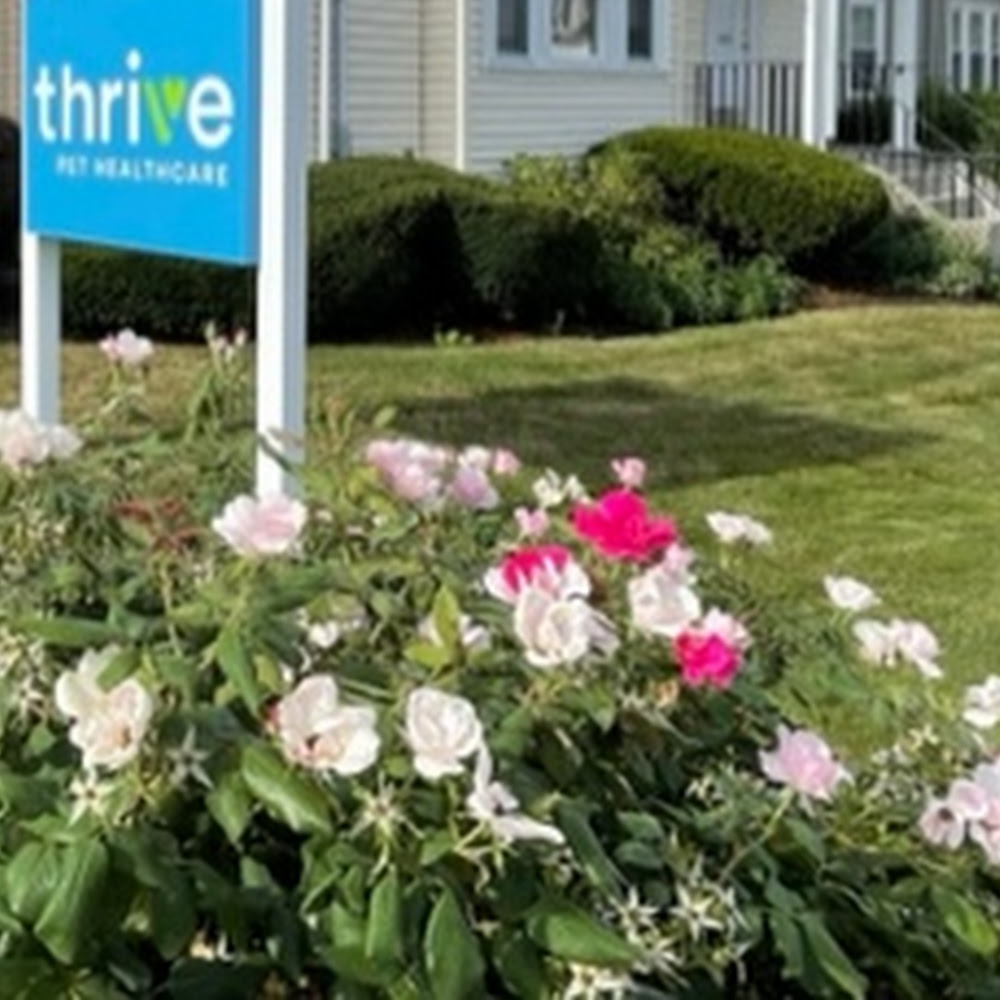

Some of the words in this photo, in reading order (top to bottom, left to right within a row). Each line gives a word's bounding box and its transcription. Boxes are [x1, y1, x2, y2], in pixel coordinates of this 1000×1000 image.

[33, 48, 235, 149] thrive
[56, 155, 88, 176] PET
[95, 157, 229, 188] HEALTHCARE
